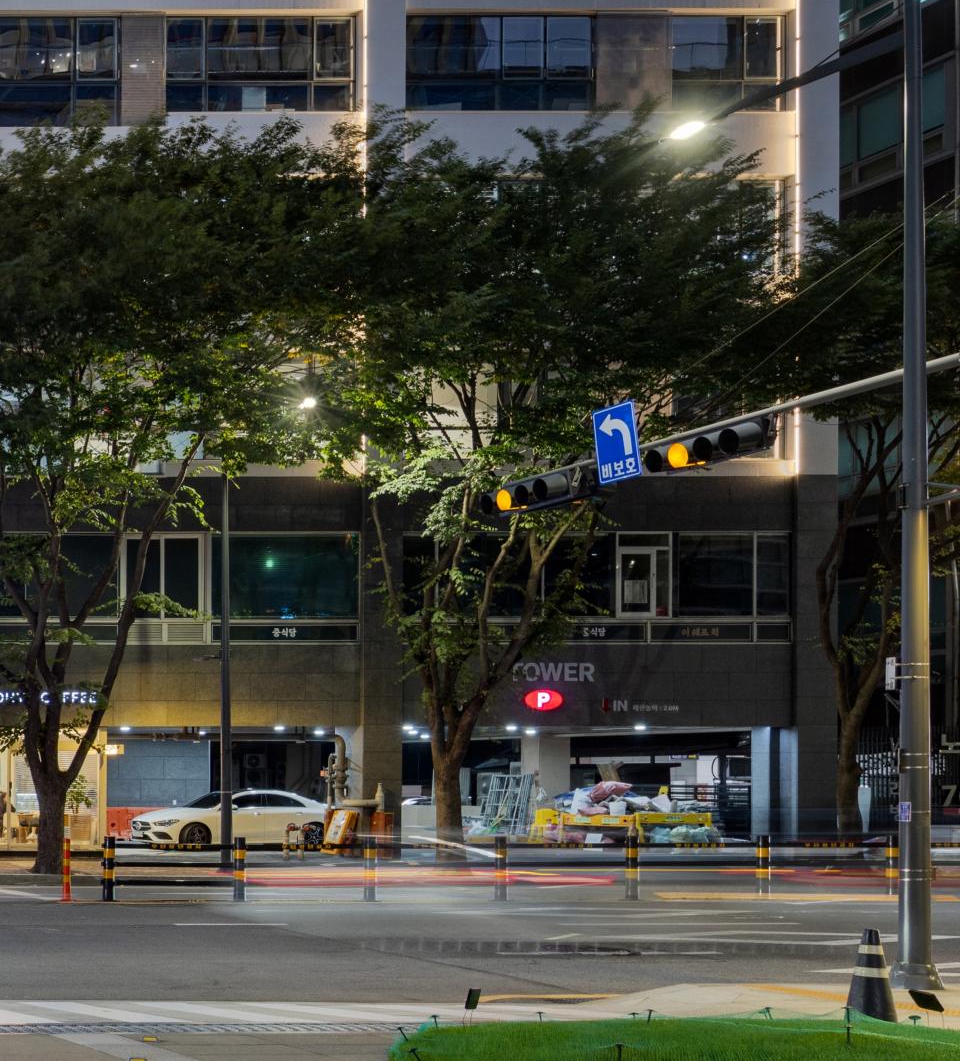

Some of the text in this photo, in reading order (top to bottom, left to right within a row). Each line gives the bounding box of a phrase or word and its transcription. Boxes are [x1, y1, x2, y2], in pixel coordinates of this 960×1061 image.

[601, 457, 637, 479] 비보호
[272, 627, 297, 637] 중식당
[40, 691, 97, 704] CFFEE
[537, 692, 550, 707] P
[613, 700, 628, 711] IN
